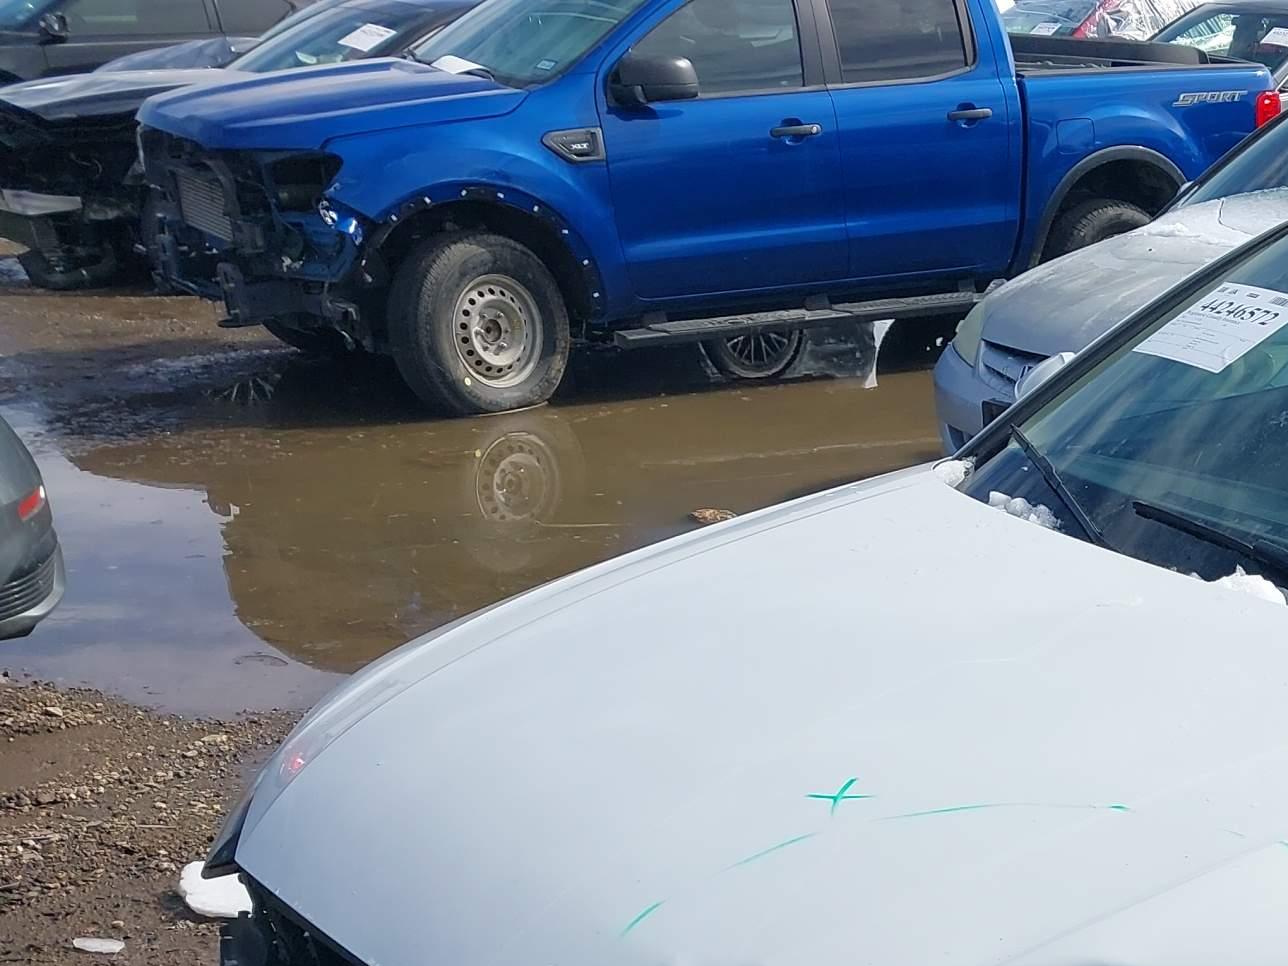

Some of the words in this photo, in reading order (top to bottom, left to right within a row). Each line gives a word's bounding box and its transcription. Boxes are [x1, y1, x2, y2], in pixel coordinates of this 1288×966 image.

[1172, 90, 1248, 107] SPORT
[569, 142, 589, 150] XLT
[1199, 298, 1280, 326] 44246572
